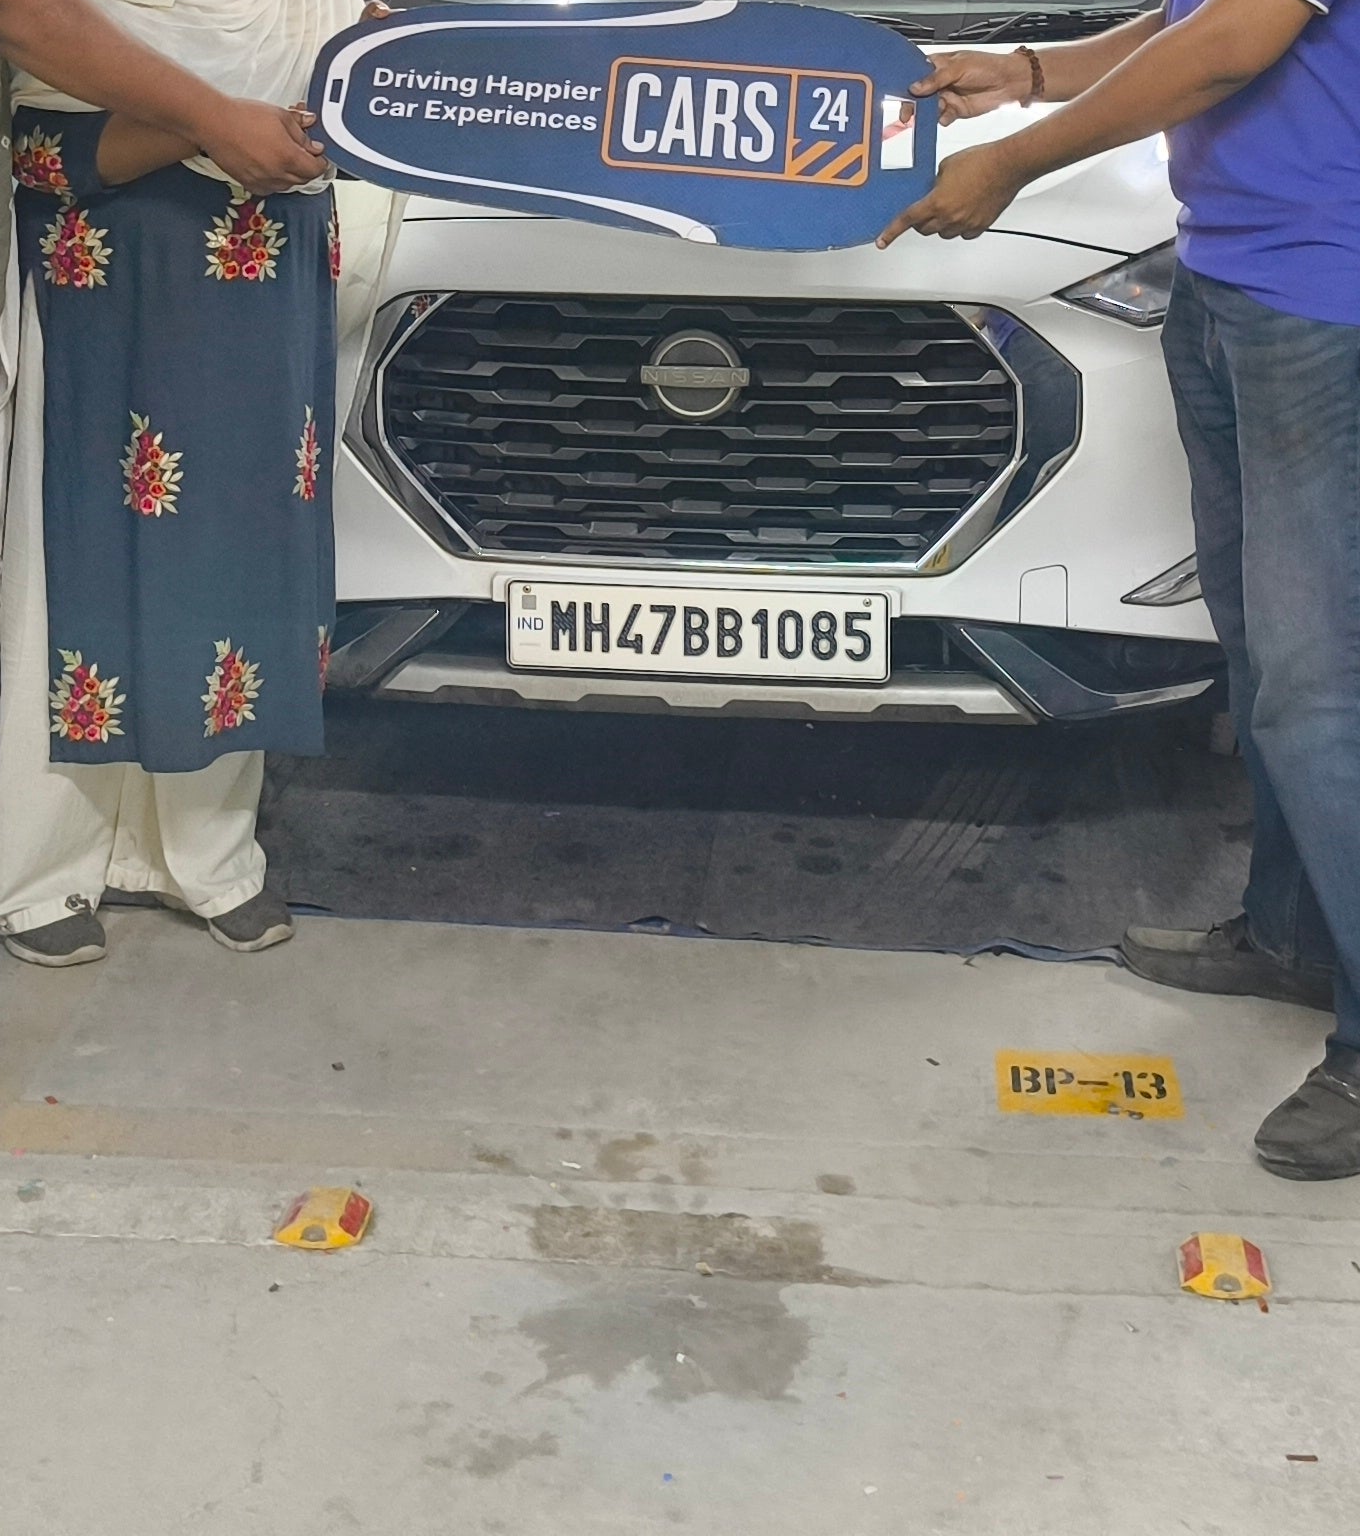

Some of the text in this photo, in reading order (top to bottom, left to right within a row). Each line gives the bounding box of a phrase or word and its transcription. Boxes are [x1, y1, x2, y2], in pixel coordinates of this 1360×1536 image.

[372, 66, 602, 103] Driving Happier
[368, 96, 598, 131] Car Experiences
[620, 72, 850, 163] CARS 24
[644, 369, 747, 384] NISSAN
[517, 600, 872, 662] IND MH47BB1085
[1010, 1065, 1168, 1100] BP-13
